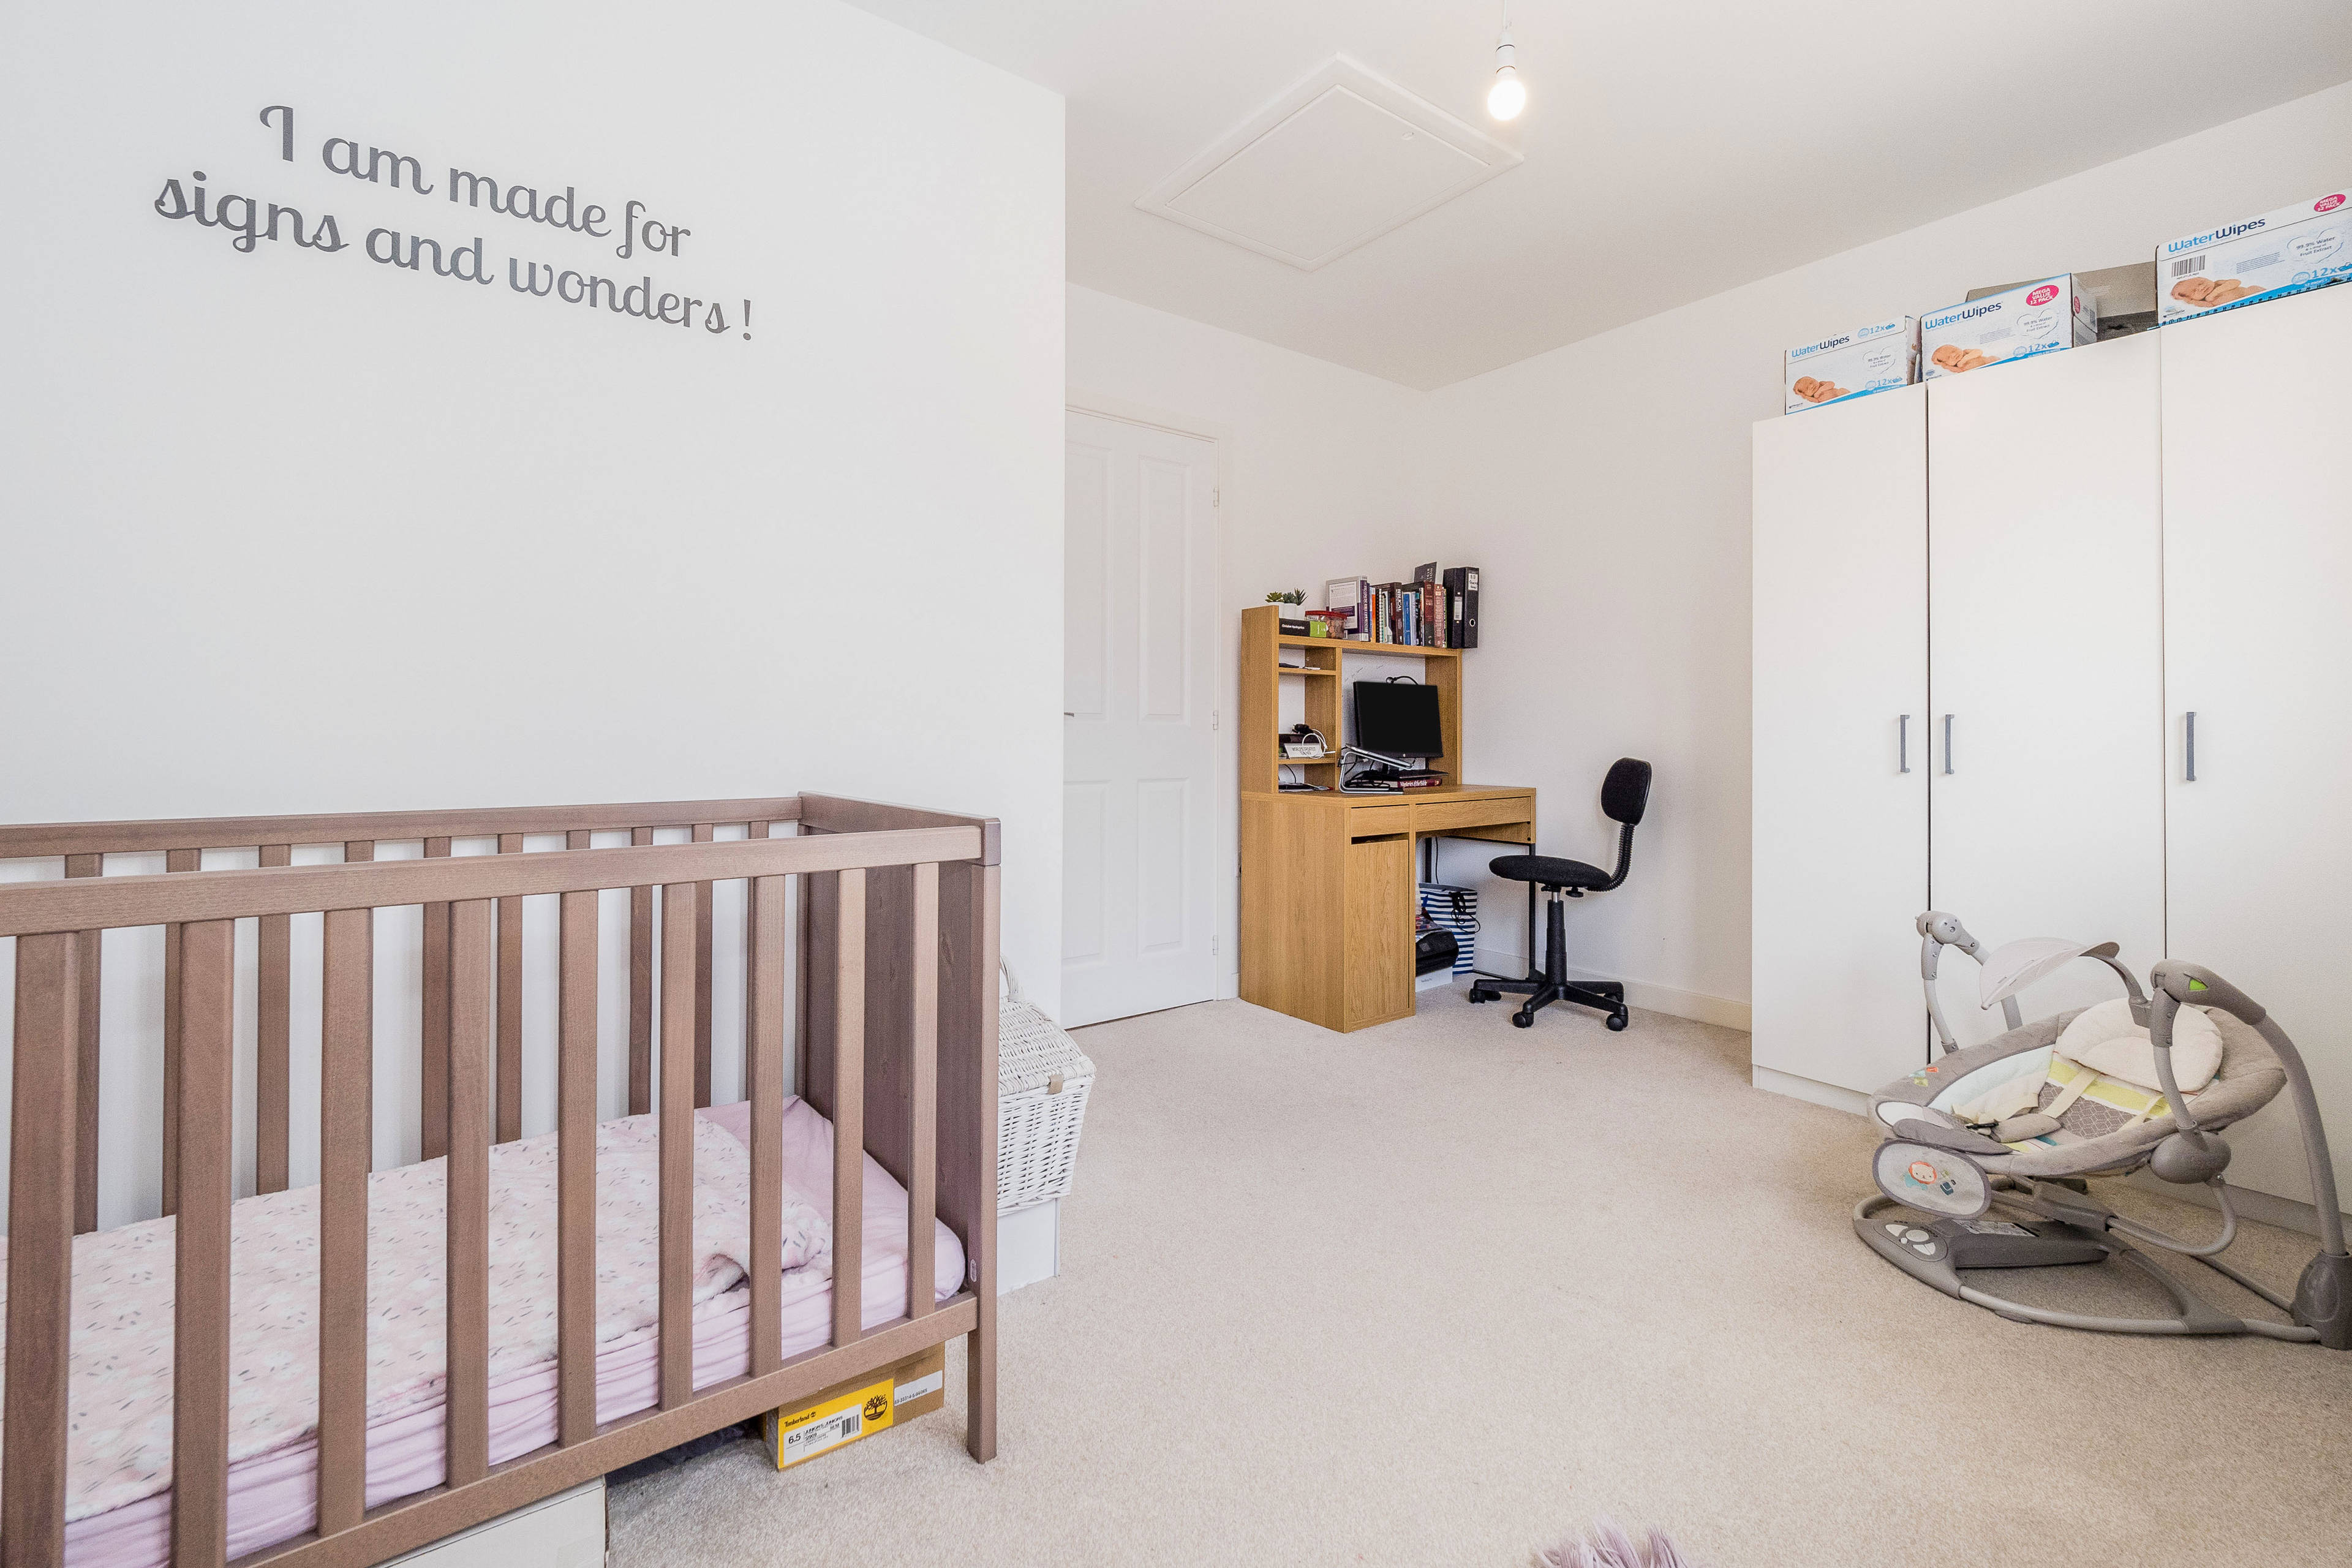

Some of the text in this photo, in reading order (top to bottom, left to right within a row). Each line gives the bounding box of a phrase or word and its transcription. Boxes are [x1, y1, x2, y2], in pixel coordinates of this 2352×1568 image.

[260, 106, 690, 258] I am made for
[154, 171, 349, 252] signs
[366, 228, 494, 284] and
[2168, 218, 2266, 253] WaterWipes
[2032, 287, 2051, 296] MEGA
[2038, 295, 2054, 303] PACK
[1925, 302, 2002, 330] WaterWipes
[1792, 335, 1850, 358] WaterWipes
[784, 1413, 810, 1427] Timberland
[788, 1433, 801, 1444] 6.5
